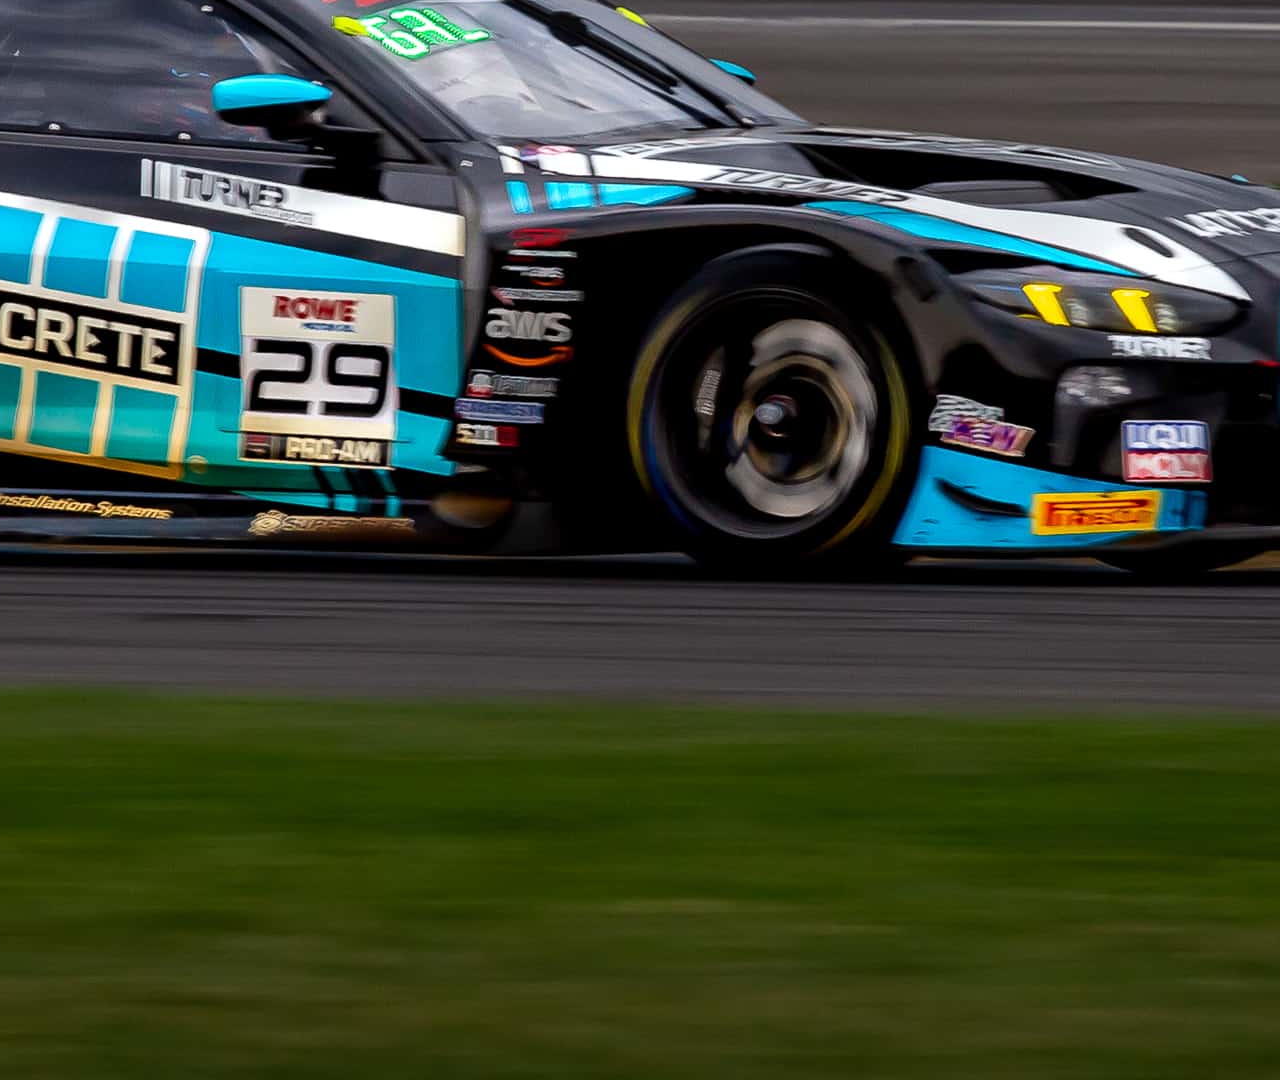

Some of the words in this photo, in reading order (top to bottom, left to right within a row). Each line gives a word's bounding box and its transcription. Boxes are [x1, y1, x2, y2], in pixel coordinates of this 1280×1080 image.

[707, 168, 911, 204] TURNER
[272, 296, 359, 322] ROWE
[485, 307, 573, 343] aws
[249, 339, 391, 419] 29
[285, 436, 382, 464] PRO-AM
[91, 500, 174, 520] Systems
